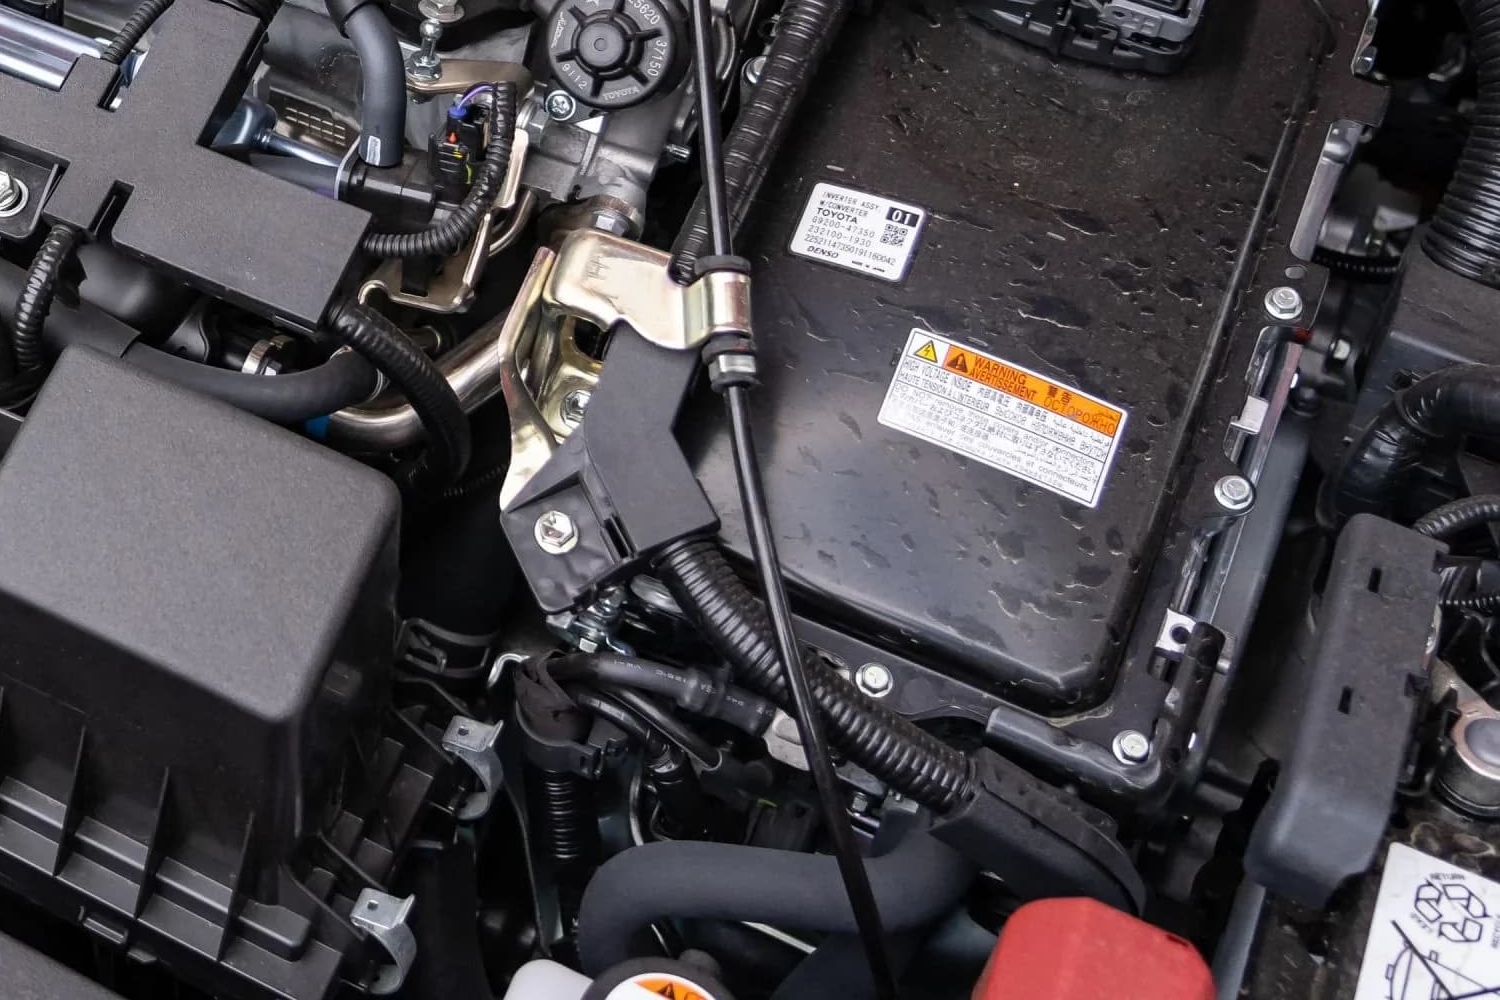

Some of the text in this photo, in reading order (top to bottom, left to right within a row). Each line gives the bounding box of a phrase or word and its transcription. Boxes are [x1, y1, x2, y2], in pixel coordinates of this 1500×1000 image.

[647, 40, 667, 76] 37150
[603, 86, 640, 101] TOYOTA
[824, 191, 858, 205] INVERTER
[817, 207, 859, 224] TOYOTA
[892, 210, 912, 224] 01
[809, 224, 872, 248] 232100-1930
[808, 245, 839, 259] DENSO
[899, 369, 920, 384] HAUTE
[920, 378, 947, 394] TENSION
[903, 358, 919, 371] HIGH
[921, 365, 949, 383] VOLTAGE
[973, 356, 1026, 385] WARNING
[968, 366, 1036, 401] AVERTISSEMENT
[1044, 399, 1116, 434] ОСТОРОЖНО
